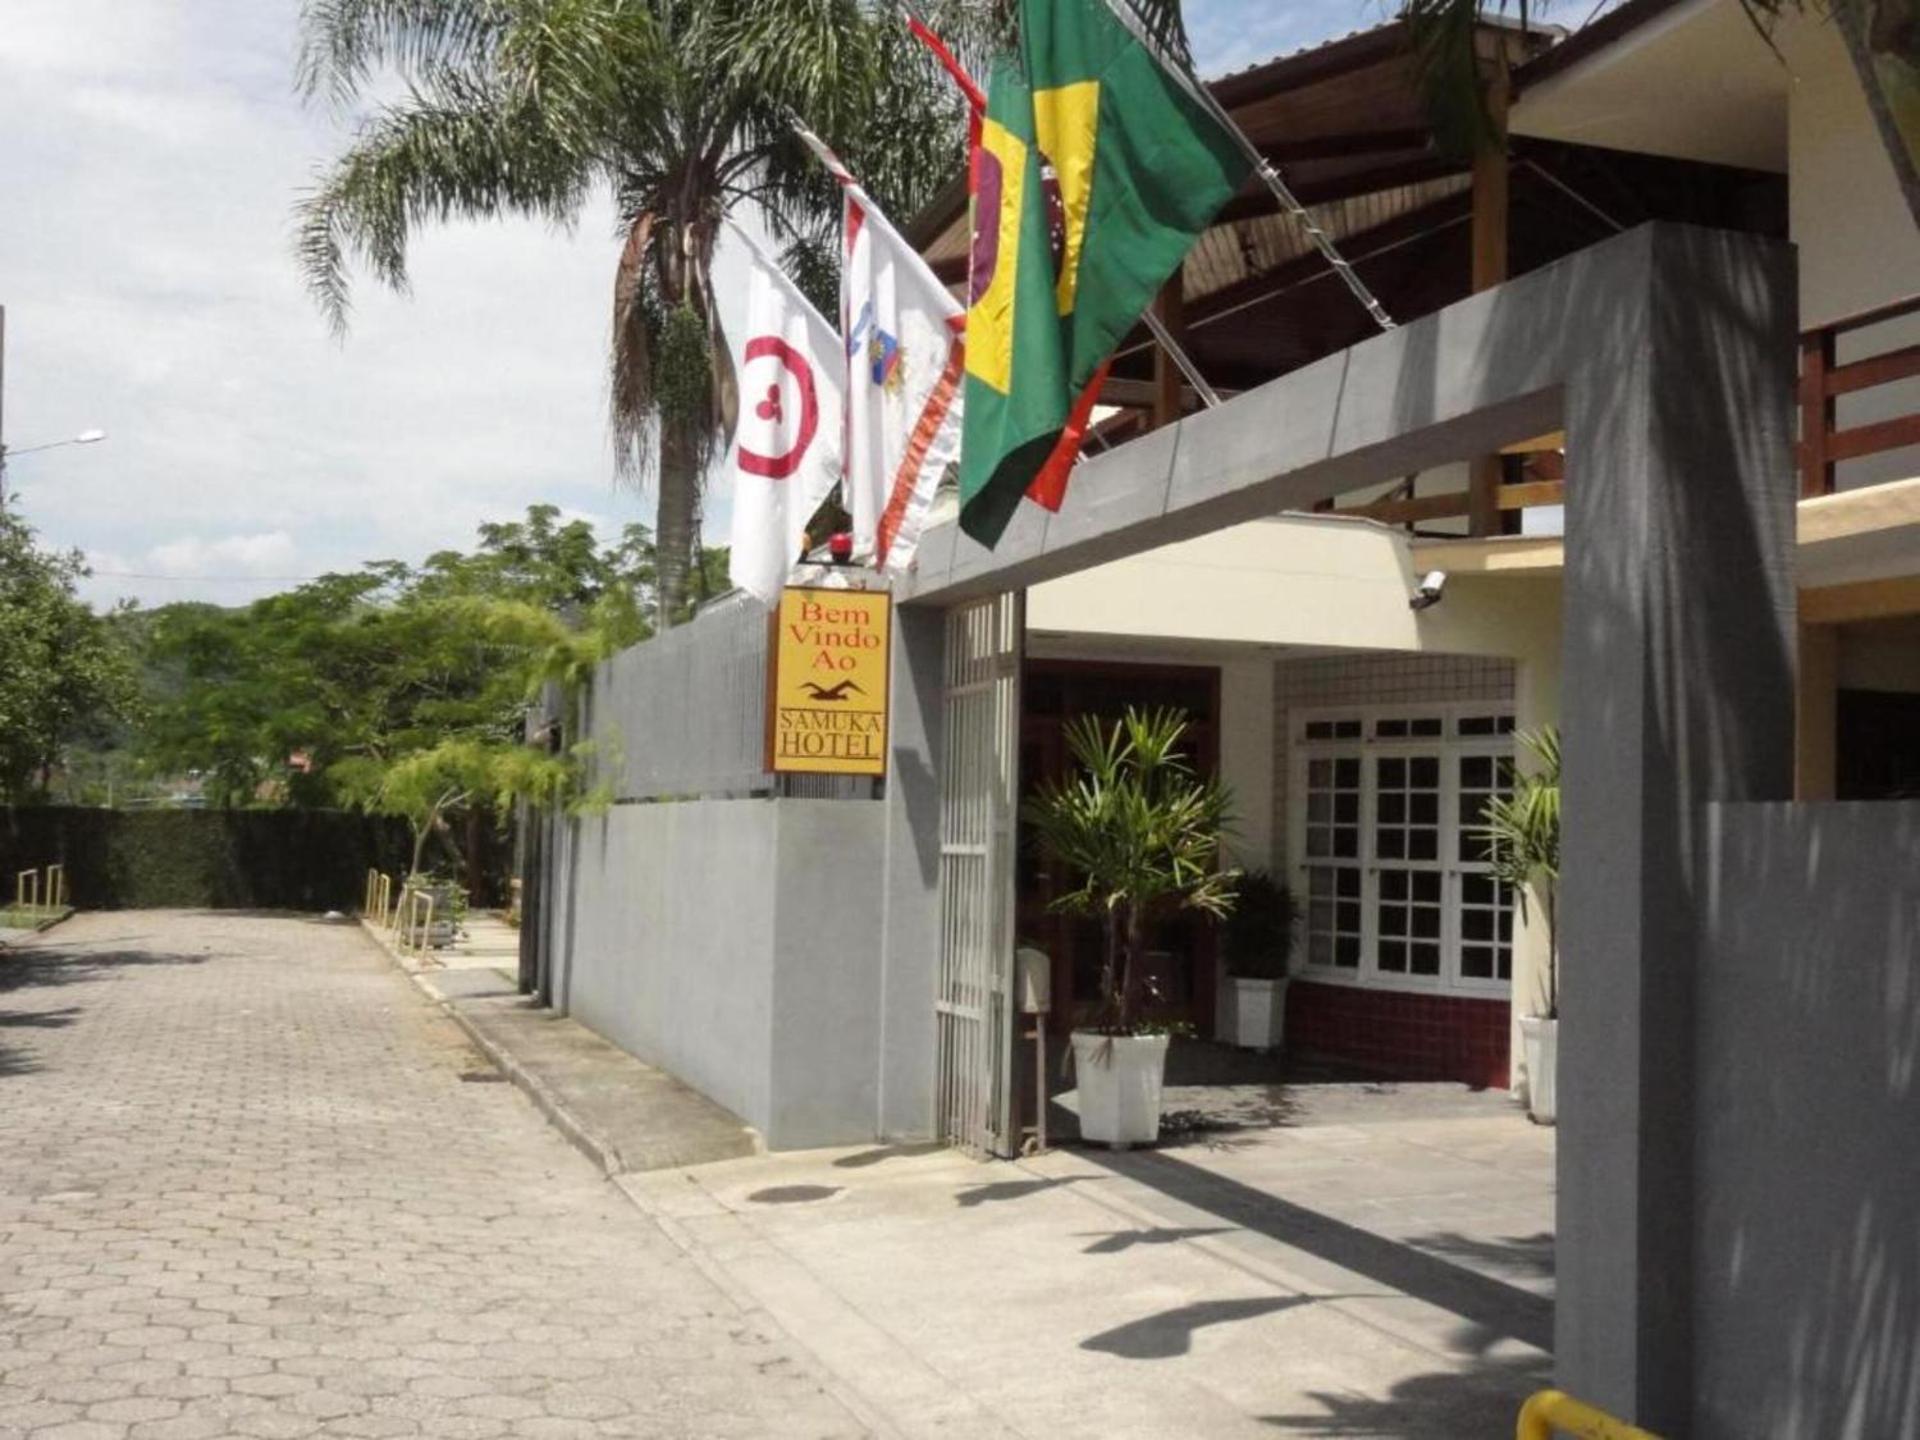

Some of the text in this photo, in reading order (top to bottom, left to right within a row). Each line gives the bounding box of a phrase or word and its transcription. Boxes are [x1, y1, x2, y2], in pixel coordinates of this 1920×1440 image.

[801, 601, 870, 626] Bem
[790, 623, 880, 649] Vindo
[813, 650, 857, 671] Ao
[780, 711, 881, 733] SAMUKA
[782, 732, 878, 757] HOTEL
